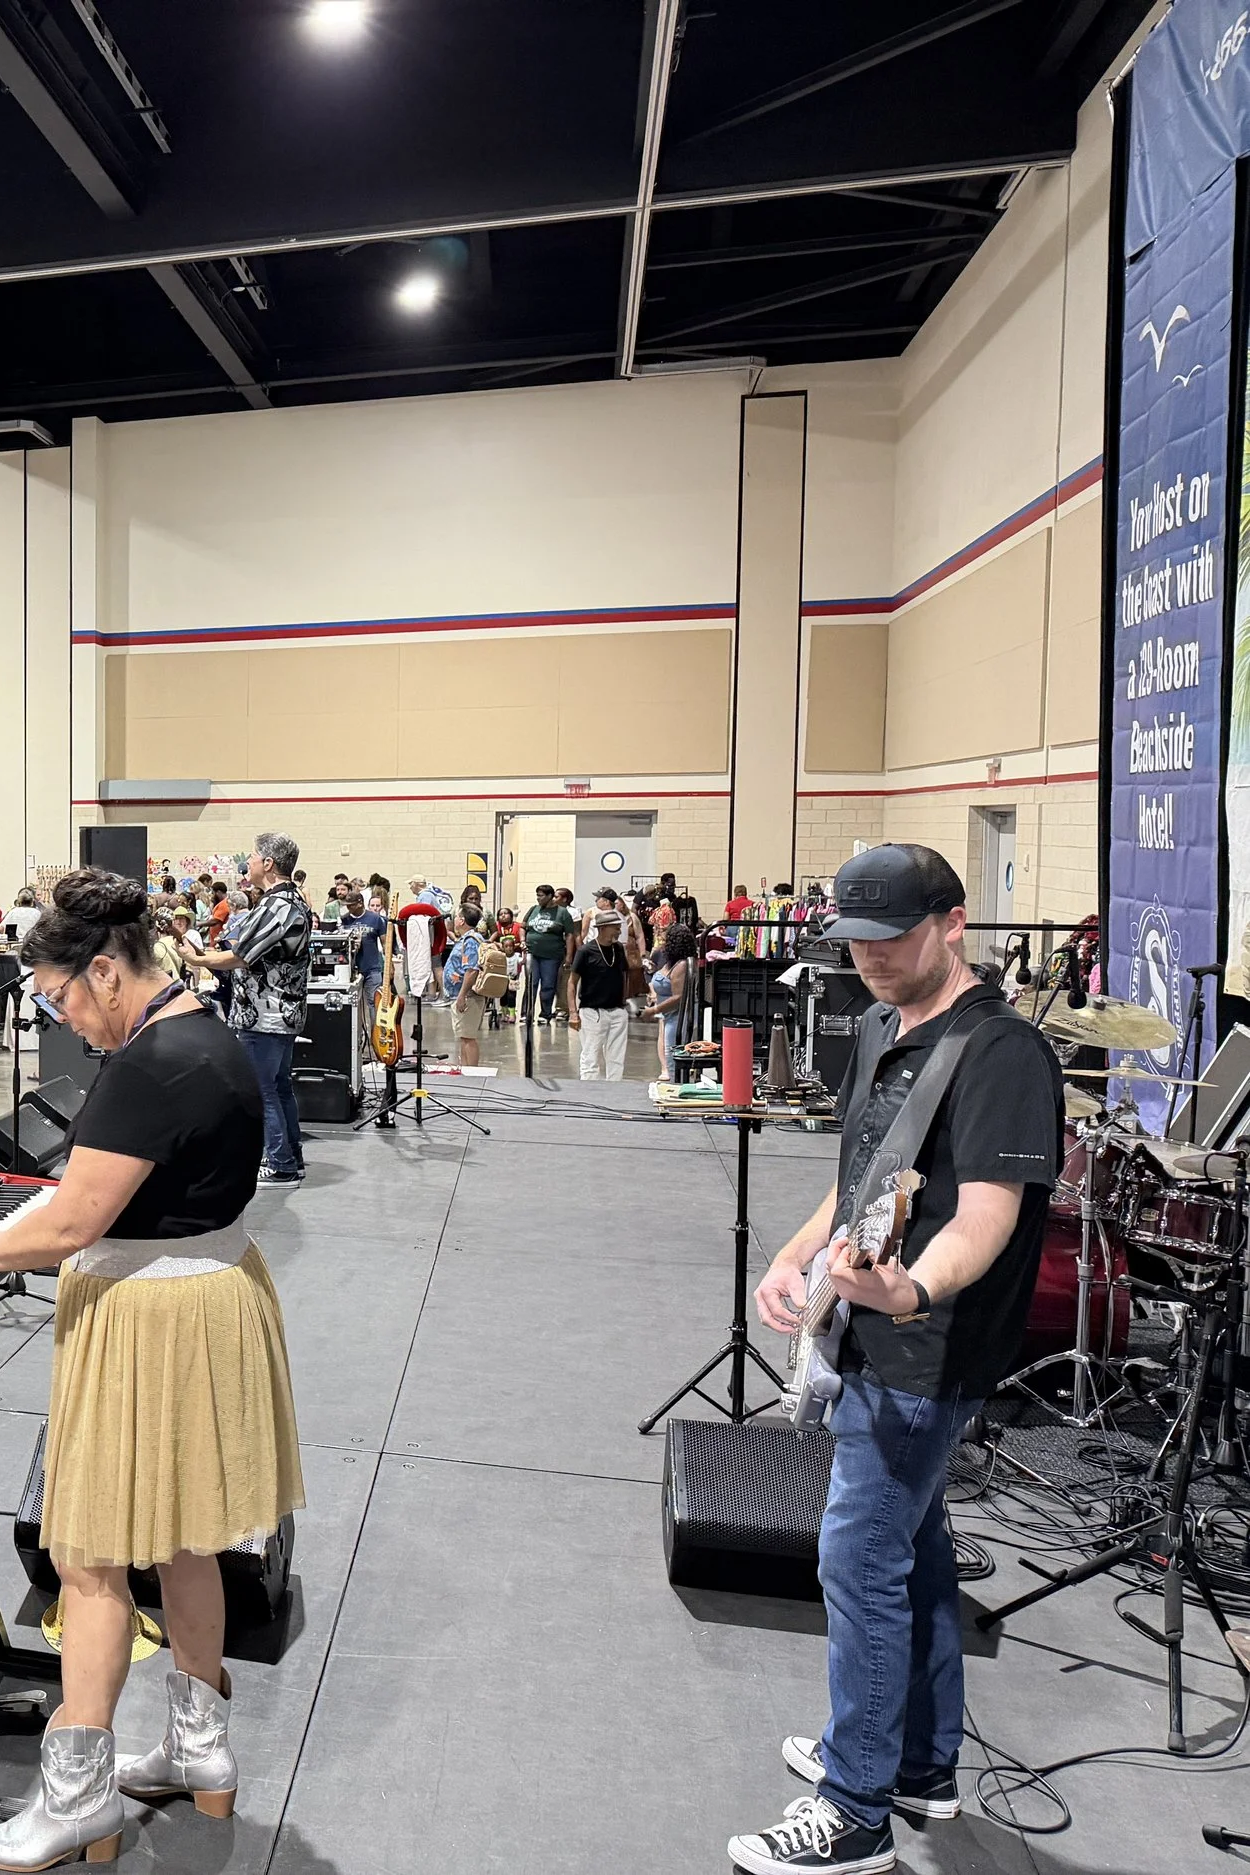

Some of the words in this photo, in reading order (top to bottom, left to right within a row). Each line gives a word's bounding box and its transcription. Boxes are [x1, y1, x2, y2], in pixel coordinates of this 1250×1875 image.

[1188, 471, 1210, 523] on
[1122, 573, 1142, 629] the
[1143, 557, 1172, 621] Coast
[1176, 539, 1214, 608] with
[1127, 659, 1136, 700] a
[1138, 636, 1199, 698] 129-Room
[1129, 711, 1194, 775] Beachside
[1139, 793, 1174, 850] Hotel!
